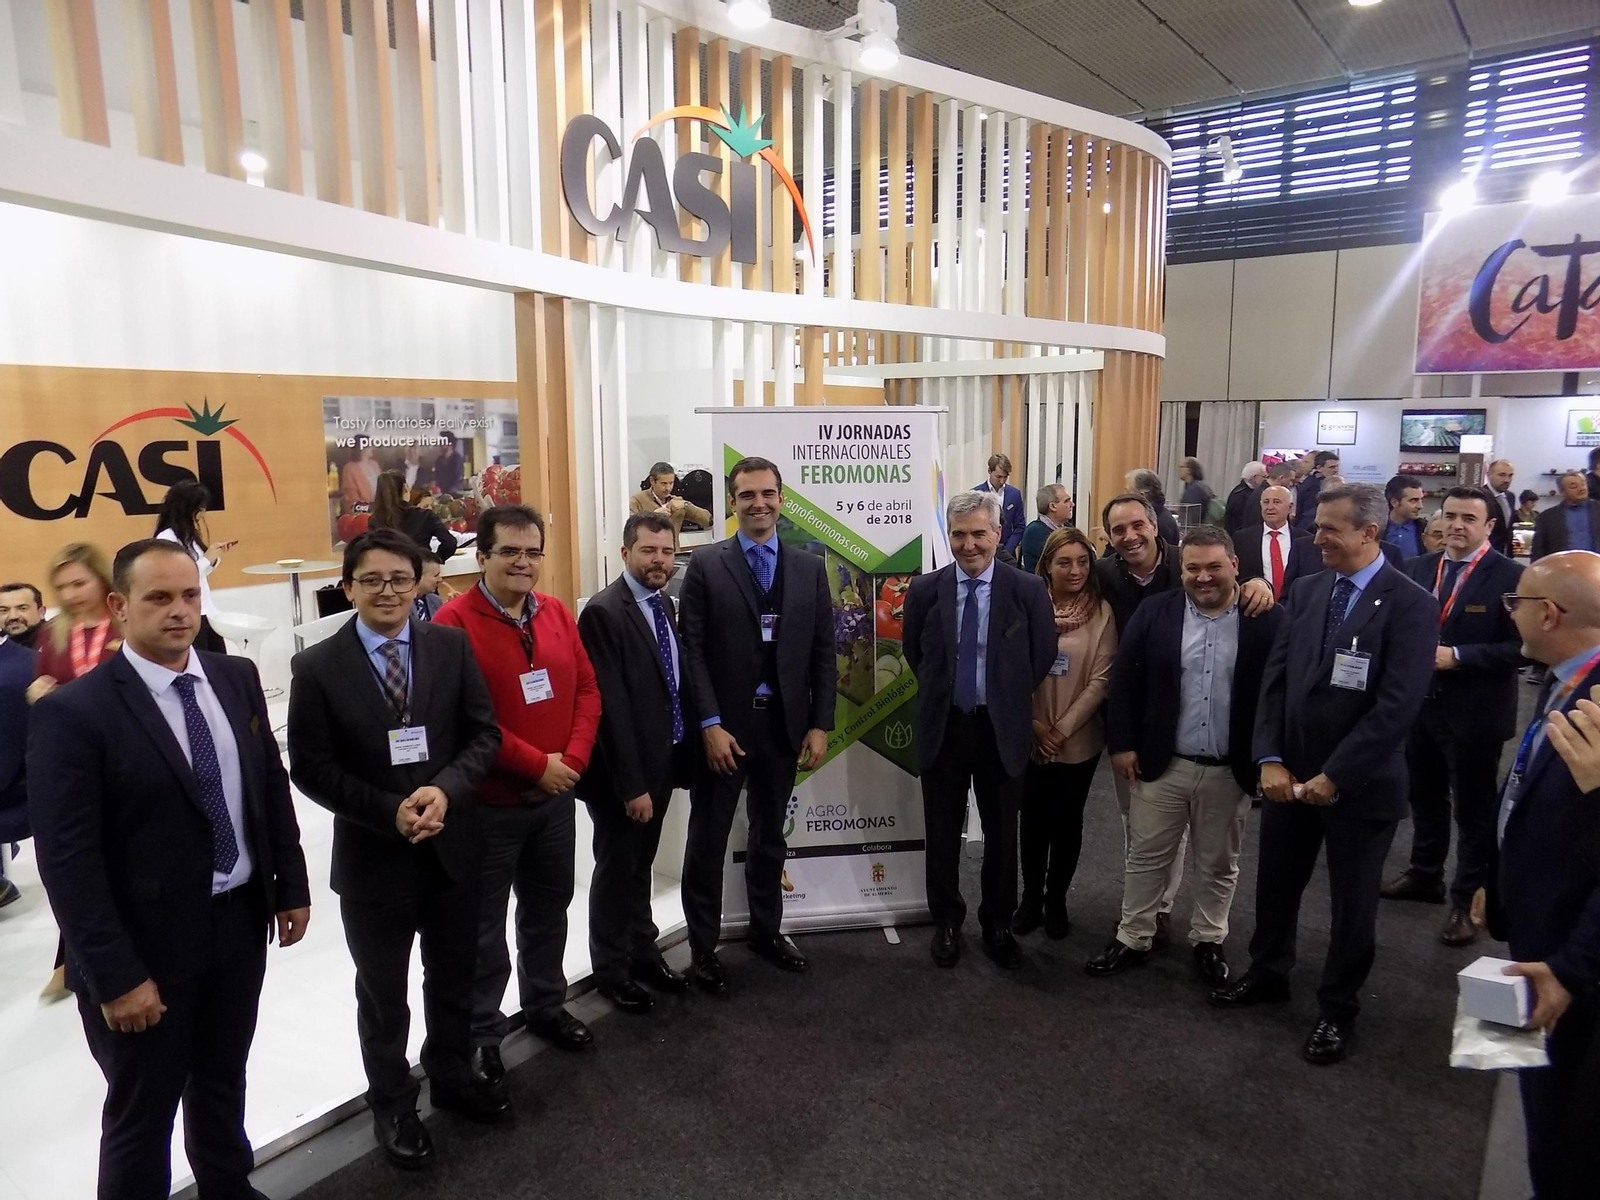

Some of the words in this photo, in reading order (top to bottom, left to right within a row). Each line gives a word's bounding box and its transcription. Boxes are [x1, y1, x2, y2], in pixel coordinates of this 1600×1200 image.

[561, 113, 756, 265] CASI
[333, 416, 368, 431] Tasty
[371, 417, 432, 429] tomatoes
[434, 417, 467, 431] really
[819, 424, 833, 440] IV
[836, 424, 911, 440] JORNADAS
[335, 437, 356, 448] we
[360, 436, 415, 450] produce
[418, 435, 453, 447] them.
[793, 443, 911, 460] INTERNACIONALES
[0, 440, 225, 521] CASI
[801, 464, 912, 484] FEROMONAS
[836, 501, 844, 511] 5
[847, 503, 854, 514] y
[857, 501, 865, 511] 6
[867, 500, 883, 511] de
[885, 500, 912, 511] abril
[866, 515, 881, 525] de
[884, 515, 912, 525] 2018
[783, 497, 869, 562] .agroferomonas.com
[838, 734, 846, 743] y
[844, 706, 876, 735] Control
[875, 678, 914, 711] Biológico
[805, 805, 847, 818] AGRO
[806, 815, 896, 832] FEROMONAS
[862, 844, 892, 852] Colabora
